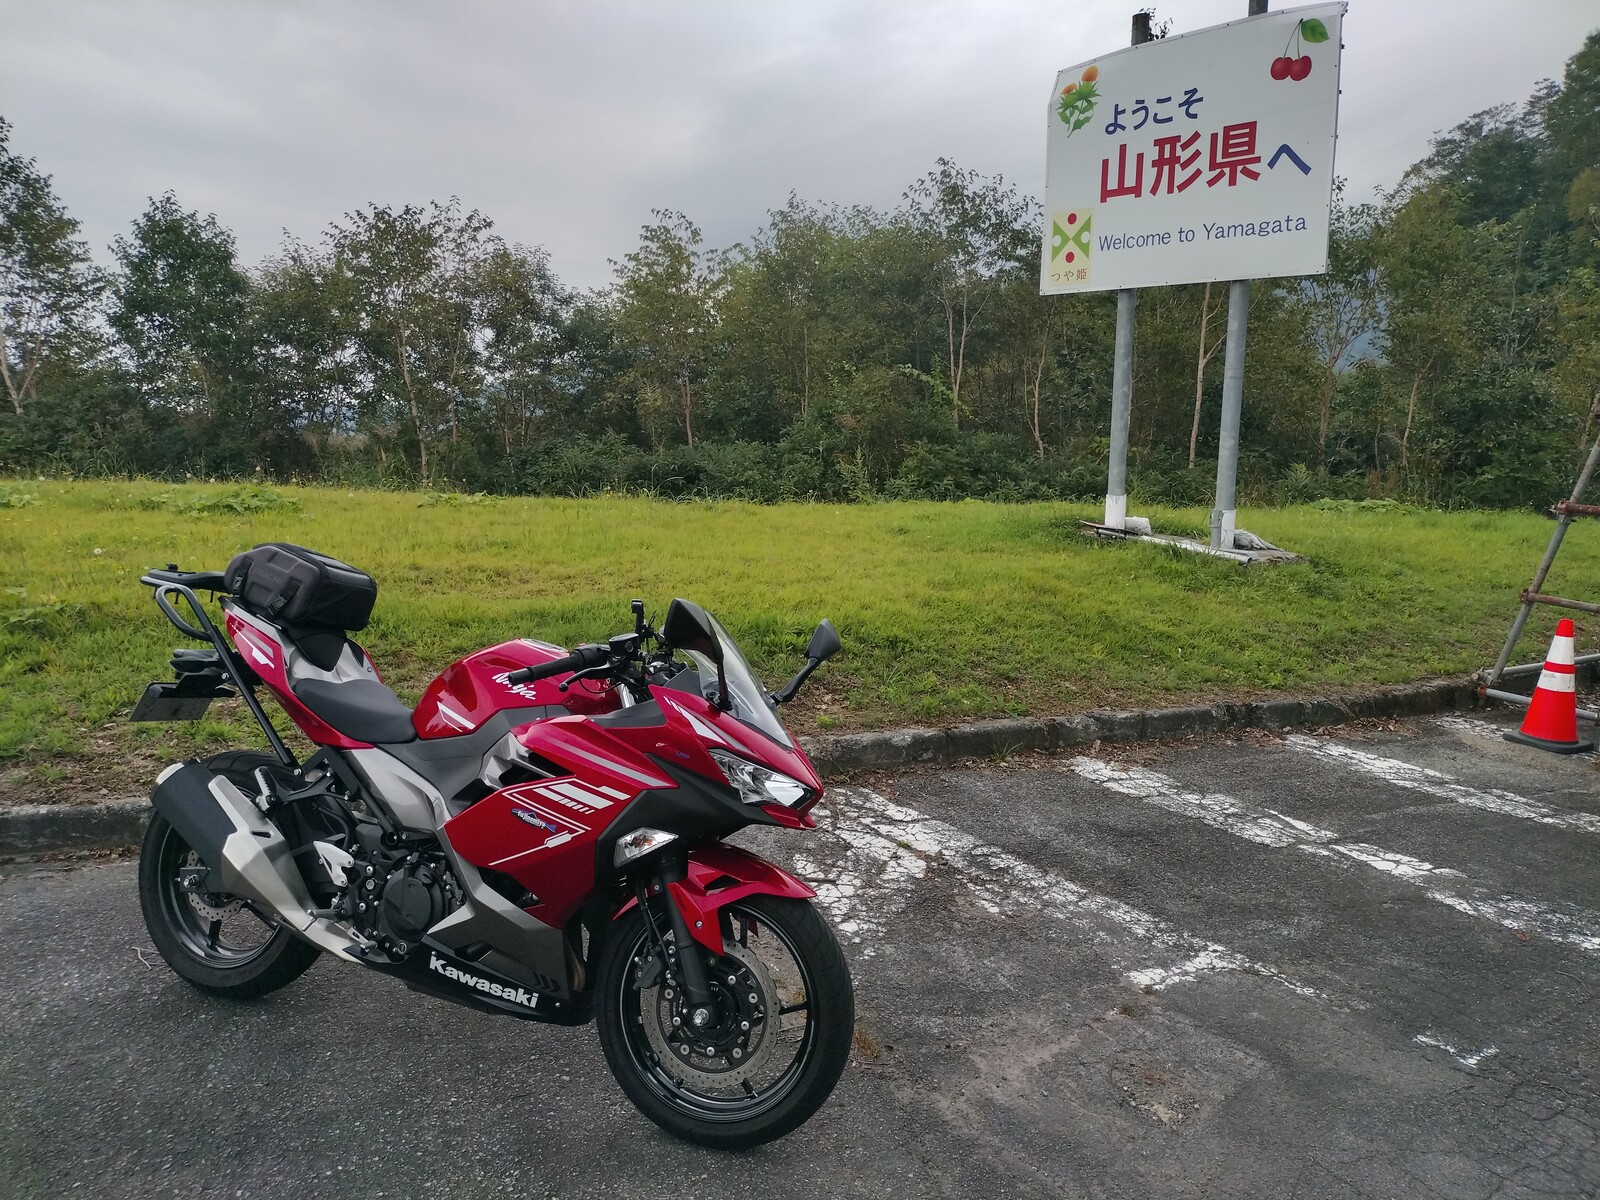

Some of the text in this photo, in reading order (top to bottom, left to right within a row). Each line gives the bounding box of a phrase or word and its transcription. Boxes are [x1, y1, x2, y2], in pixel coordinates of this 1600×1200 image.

[1104, 87, 1204, 135] ようこそ
[1100, 120, 1312, 203] 山形県へ
[1098, 214, 1308, 252] Welcome to Yamagata
[1051, 267, 1088, 281] つや姫
[429, 955, 540, 1008] Kawasaki
